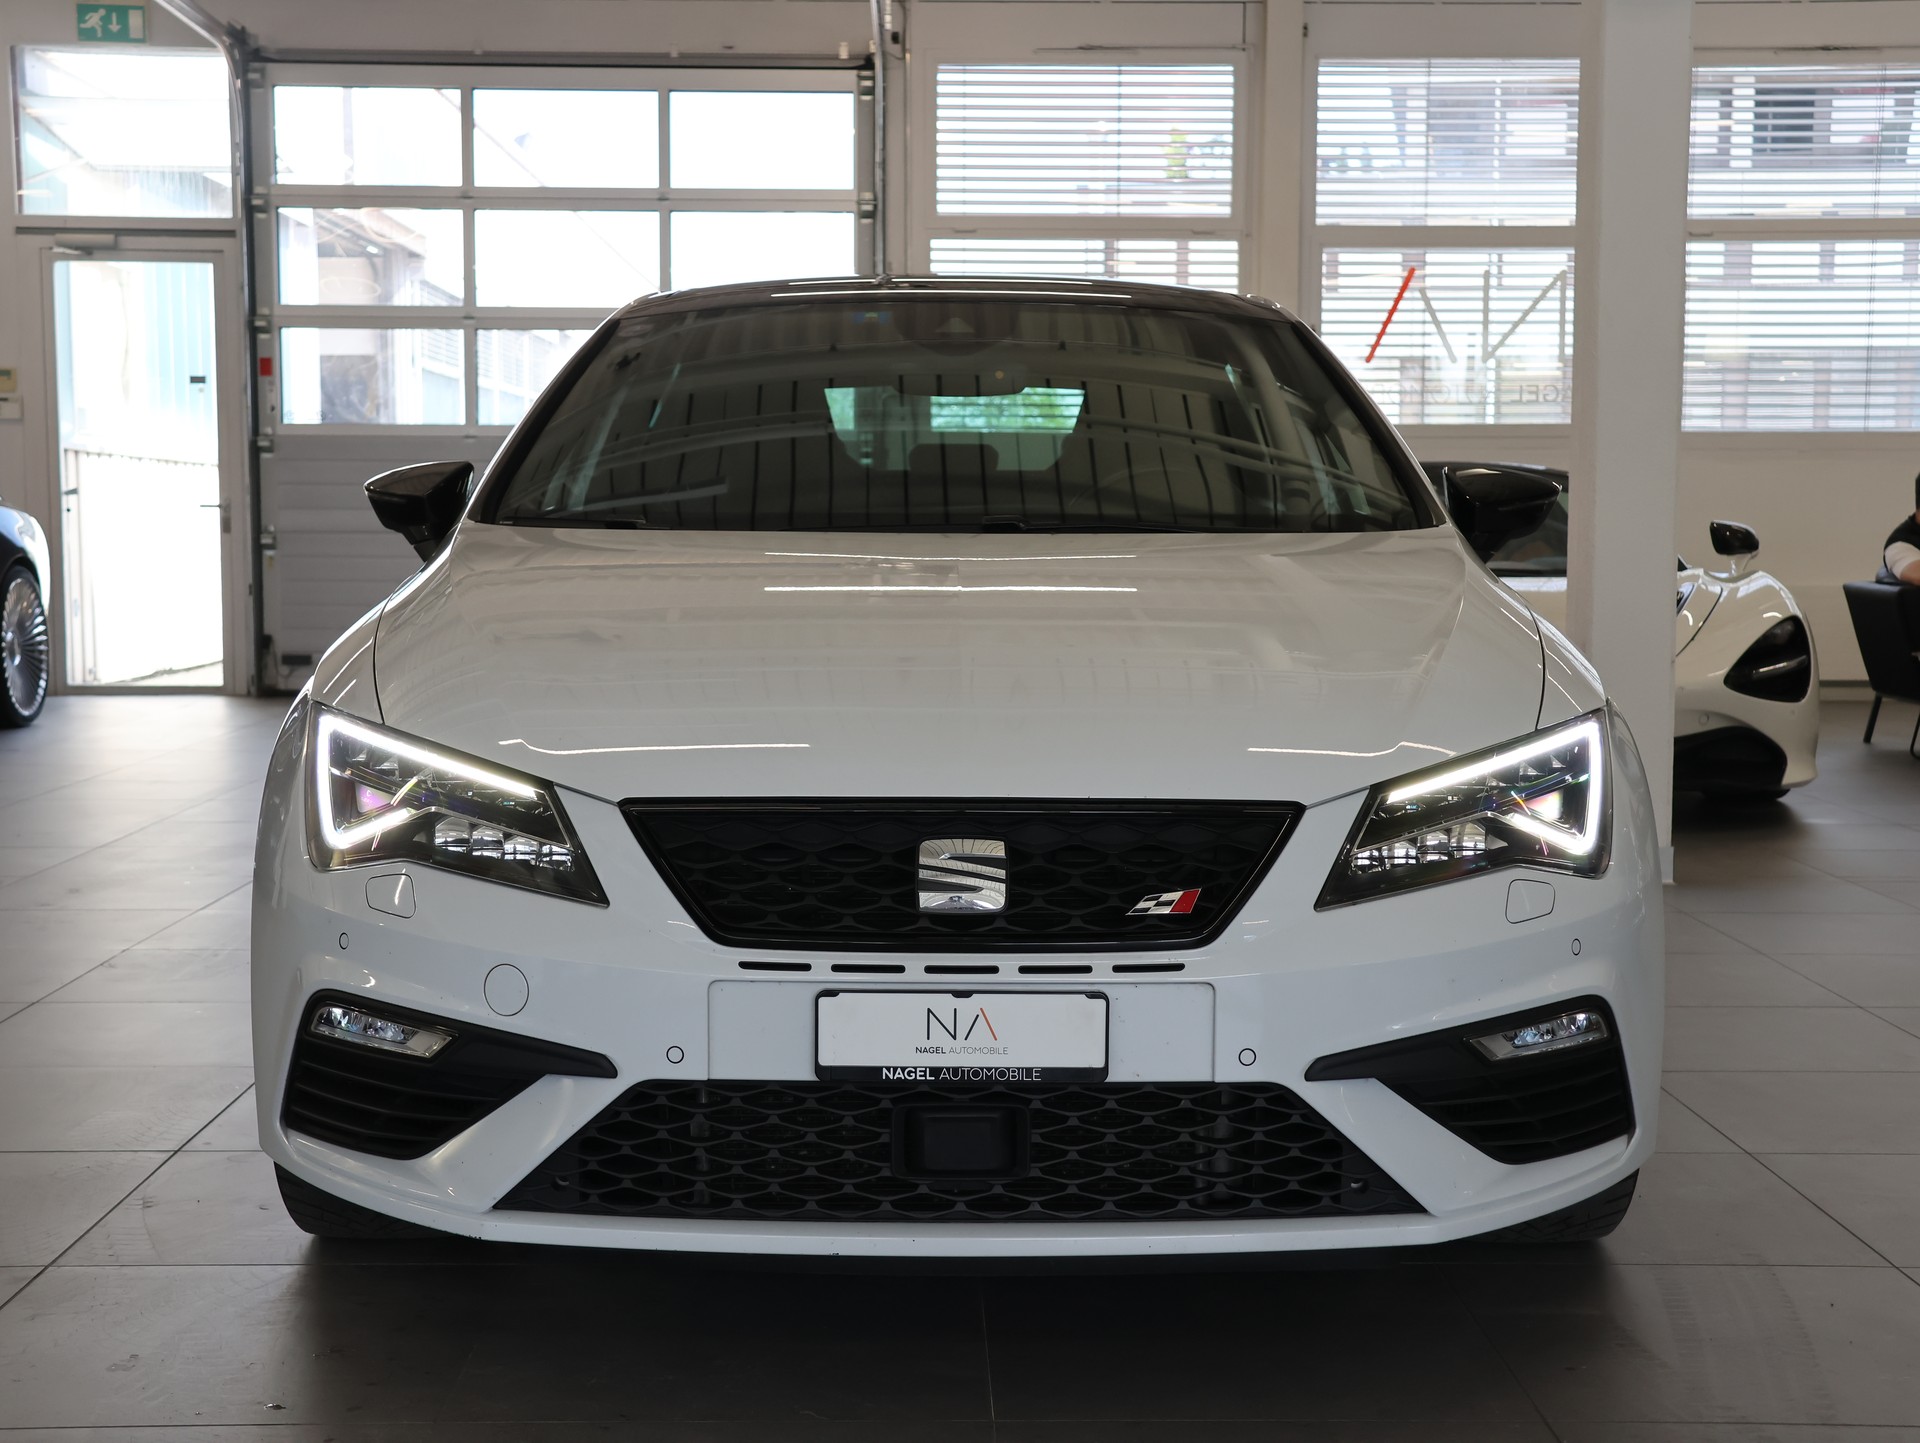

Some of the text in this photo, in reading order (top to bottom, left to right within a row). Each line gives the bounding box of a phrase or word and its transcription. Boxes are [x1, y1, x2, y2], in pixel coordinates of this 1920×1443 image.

[915, 1046, 1009, 1056] NAGEL AUTOMOBILE
[882, 1067, 1042, 1081] NAGEL AUTOMOBILE
